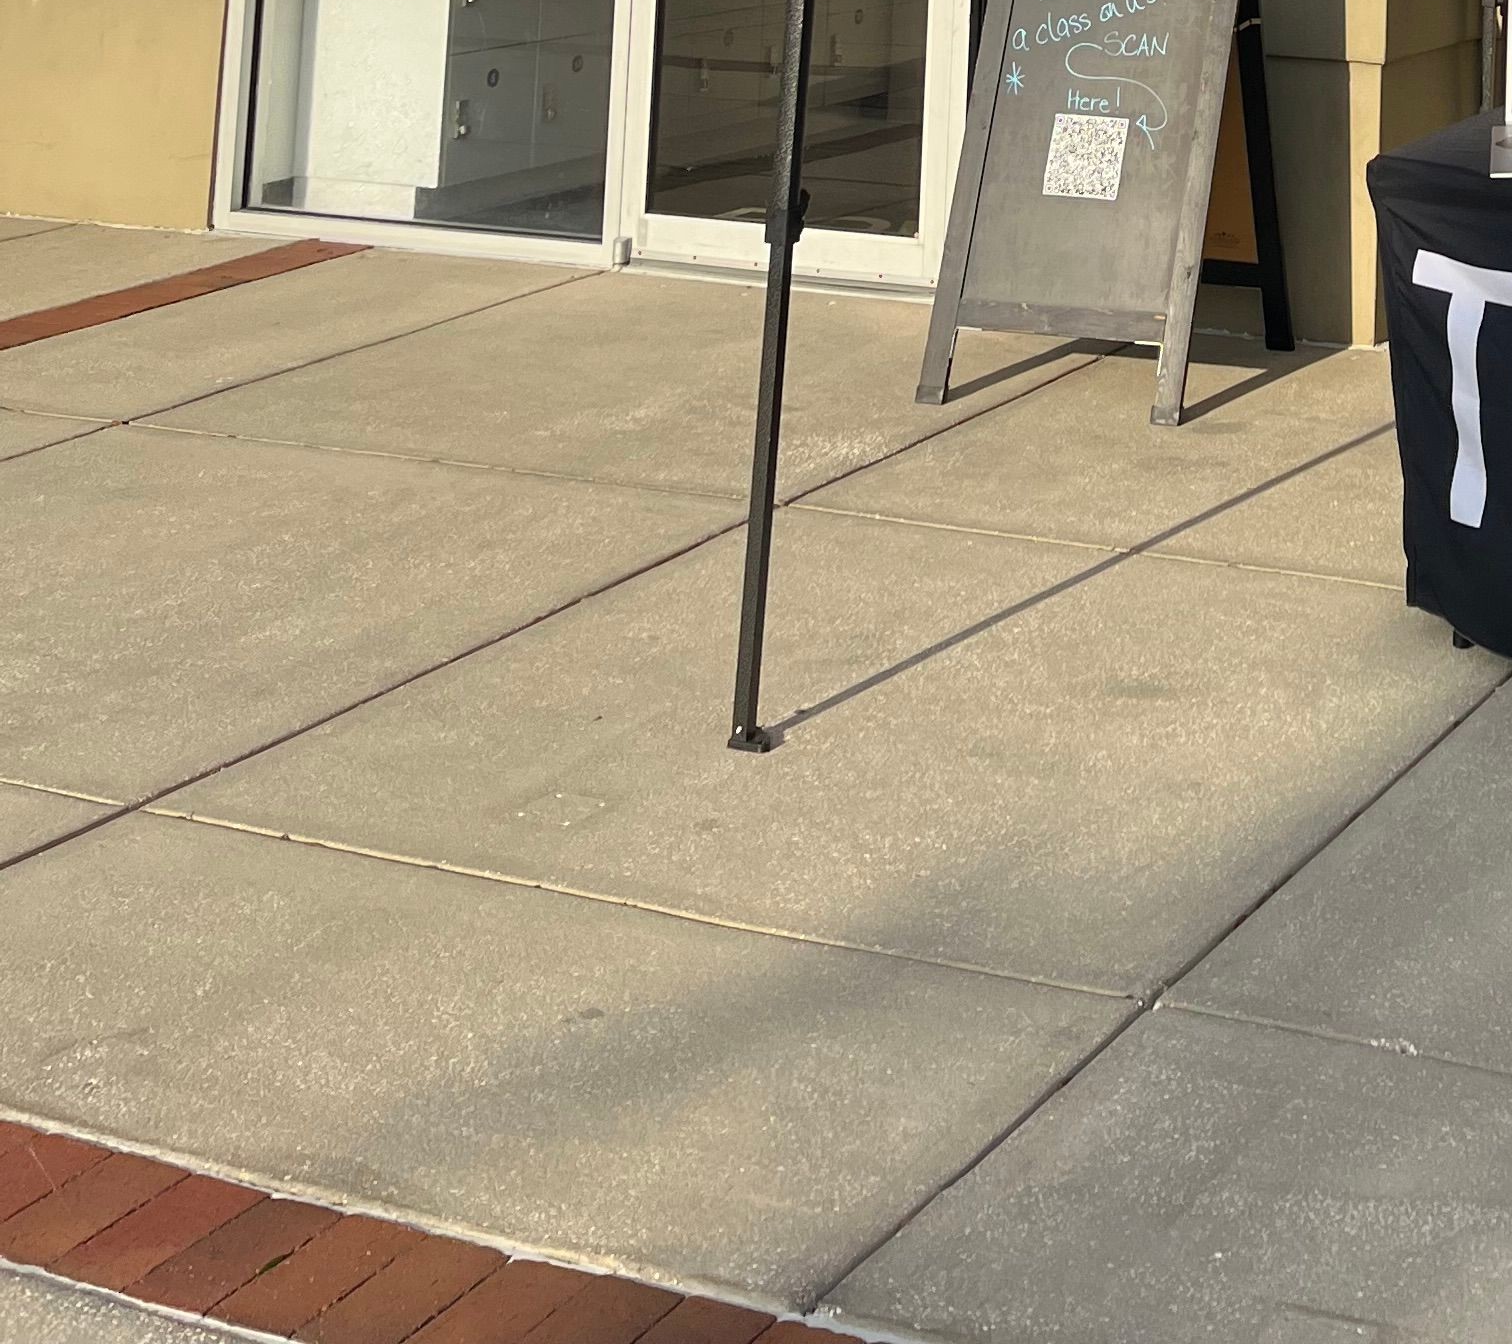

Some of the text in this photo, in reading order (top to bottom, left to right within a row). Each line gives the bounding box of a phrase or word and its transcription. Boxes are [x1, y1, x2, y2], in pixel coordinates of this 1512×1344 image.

[1012, 28, 1030, 52] a
[1035, 12, 1092, 44] class
[1103, 31, 1170, 56] SCAN
[1067, 86, 1121, 114] Here!
